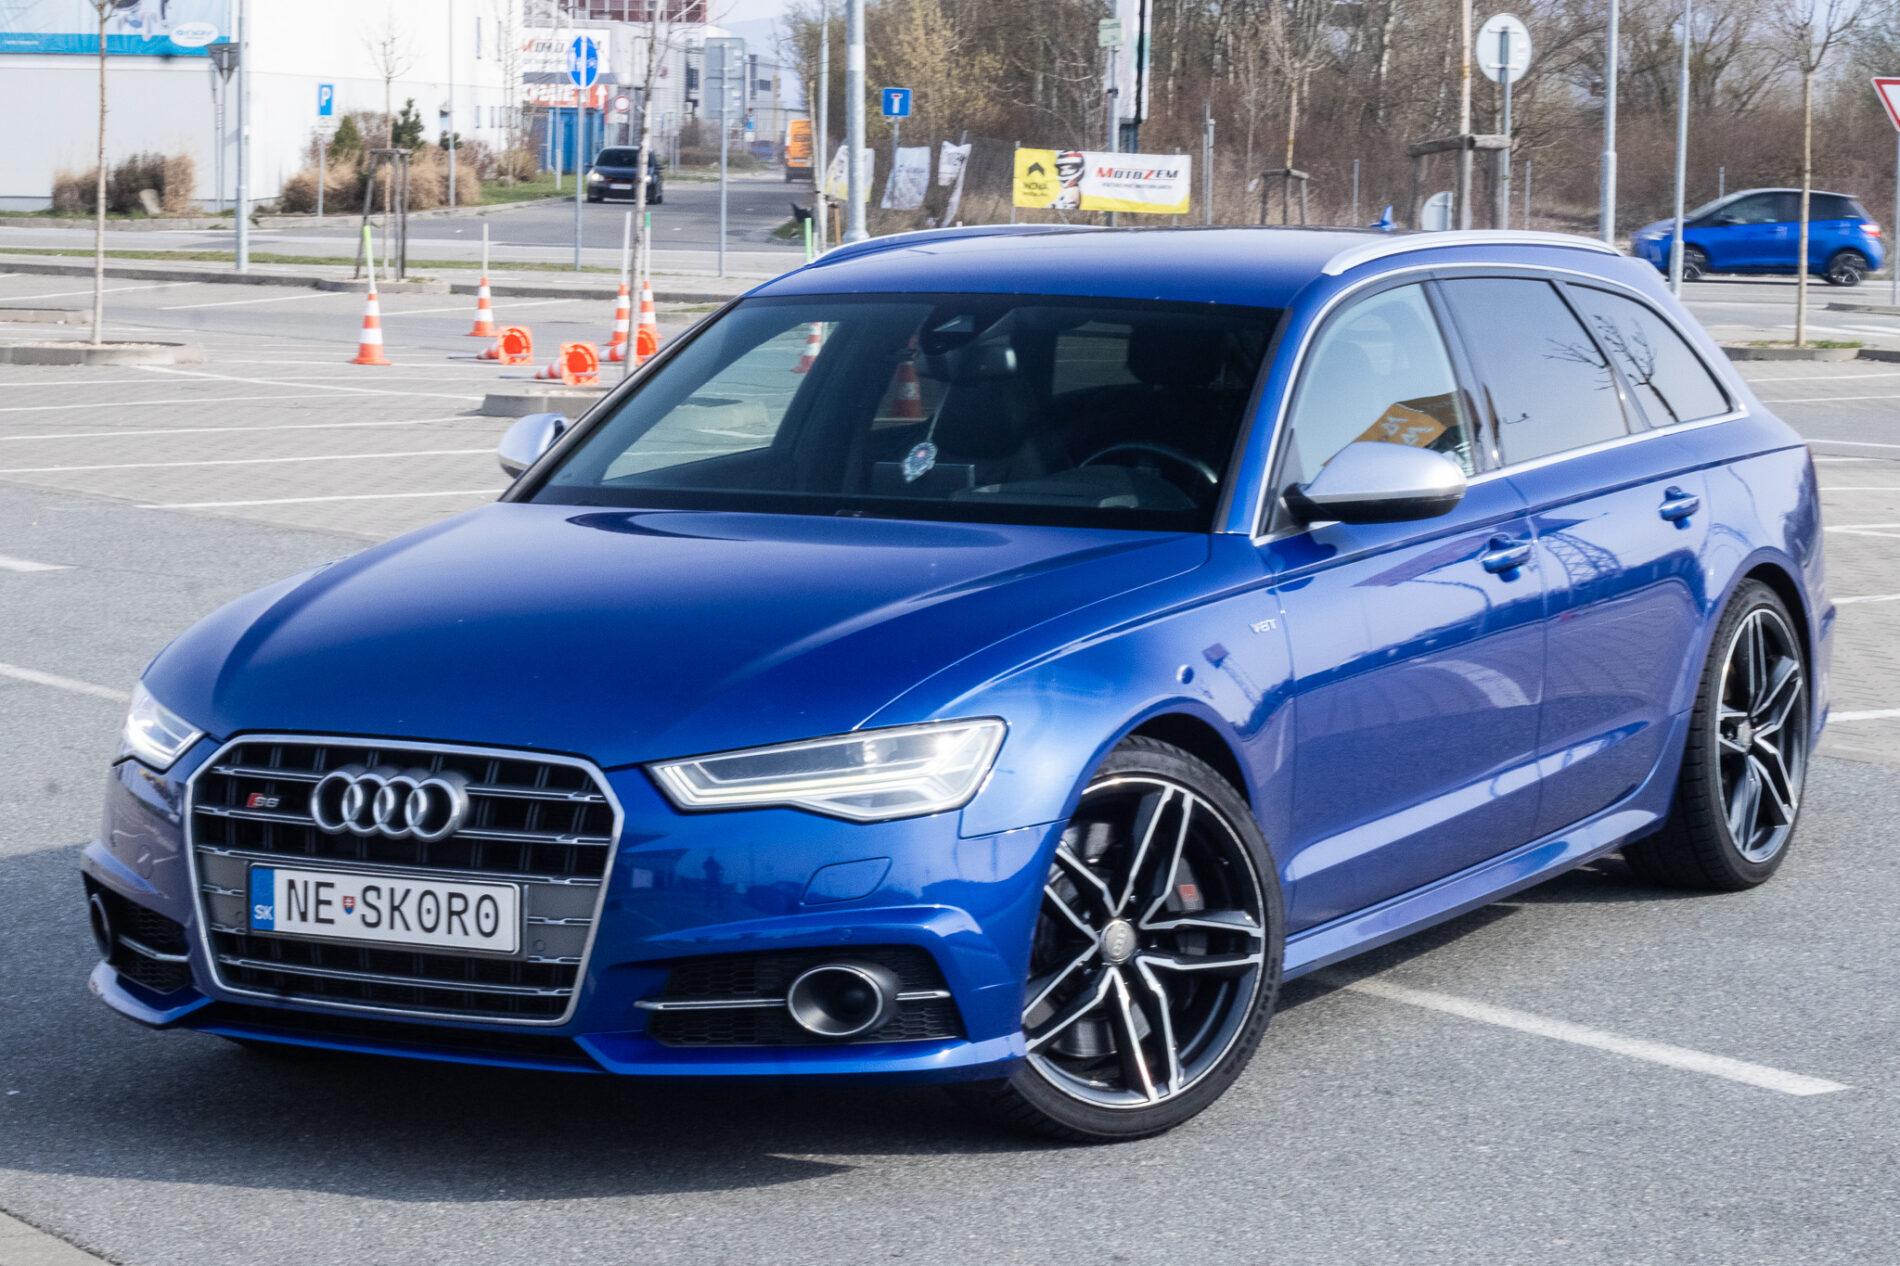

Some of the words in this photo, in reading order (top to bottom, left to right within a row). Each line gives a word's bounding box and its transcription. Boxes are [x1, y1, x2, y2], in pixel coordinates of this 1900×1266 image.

[321, 87, 331, 106] P
[254, 796, 280, 807] S6
[287, 879, 335, 924] NE
[254, 905, 273, 920] SK
